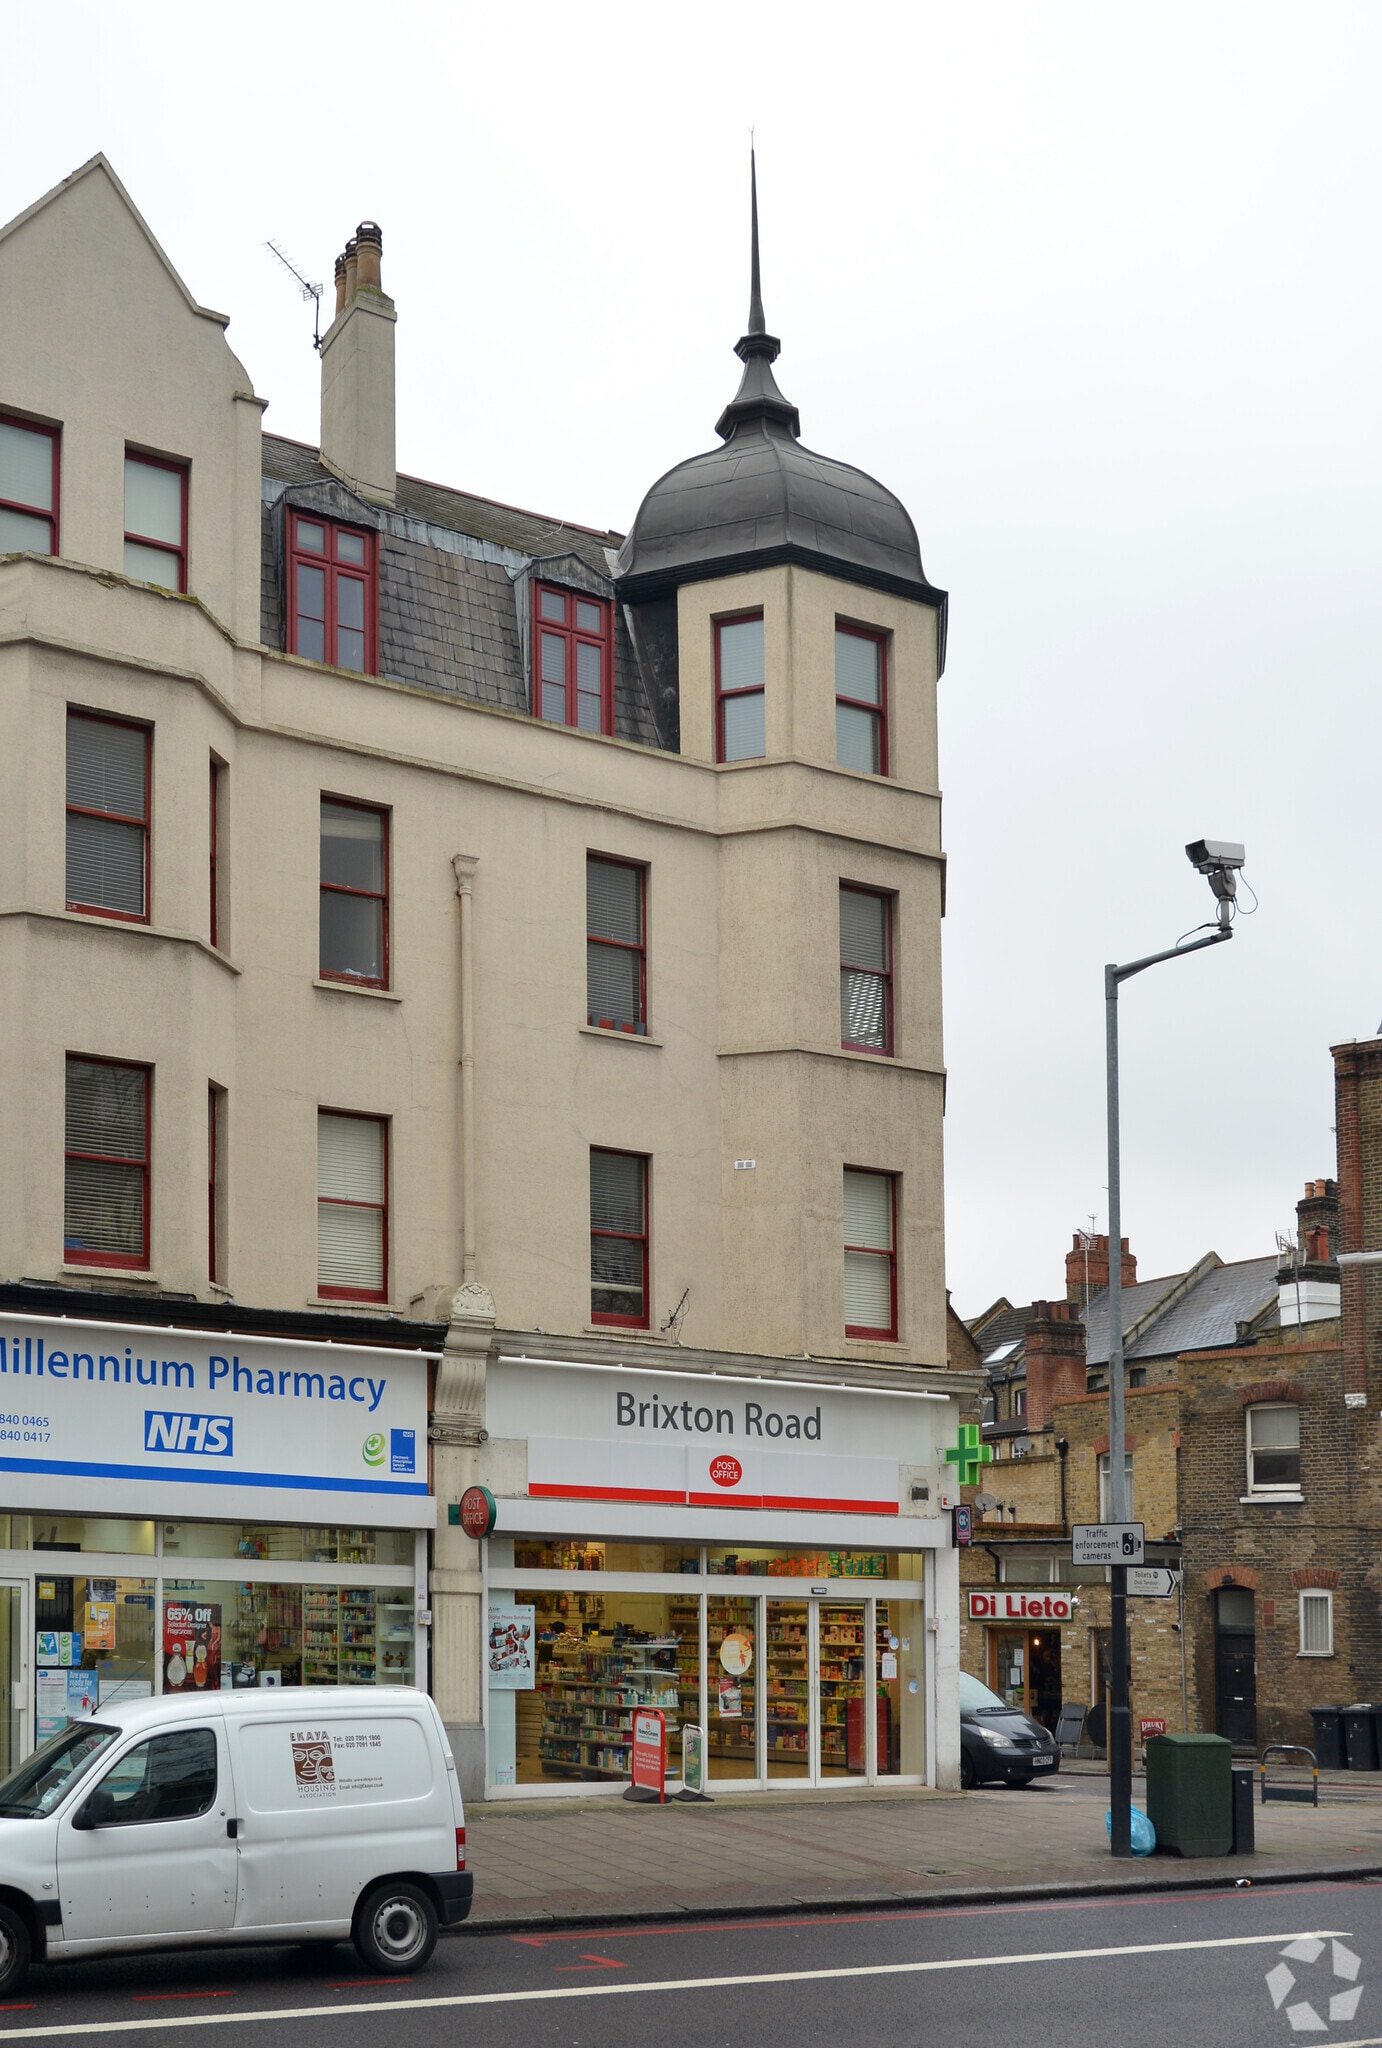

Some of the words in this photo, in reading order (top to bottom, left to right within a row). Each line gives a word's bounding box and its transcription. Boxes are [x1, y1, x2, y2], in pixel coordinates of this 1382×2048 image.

[0, 1337, 195, 1388] illennium
[209, 1356, 386, 1412] Pharmacy
[0, 1413, 19, 1425] 840
[22, 1415, 49, 1427] 0465
[616, 1391, 734, 1434] Brixton
[745, 1402, 821, 1441] Road
[0, 1429, 21, 1441] 840
[23, 1431, 51, 1443] 0417
[146, 1414, 230, 1453] NHS
[716, 1461, 736, 1470] POST
[712, 1469, 739, 1480] OFFICE
[464, 1497, 481, 1510] POST
[462, 1511, 484, 1525] OFFICE
[1085, 1529, 1108, 1538] Traffic
[1075, 1540, 1119, 1549] enforcement
[1082, 1552, 1112, 1560] cameras
[971, 1594, 996, 1616] Di
[1006, 1595, 1068, 1617] Lieto
[167, 1608, 193, 1621] 65%
[195, 1608, 212, 1621] Off
[68, 1671, 78, 1679] Are
[79, 1672, 89, 1680] you
[68, 1679, 84, 1687] ready
[1141, 1721, 1164, 1731] DRURY
[289, 1731, 330, 1741] EKAYA
[638, 1728, 659, 1736] MoneyGram
[298, 1784, 336, 1793] HOUSING
